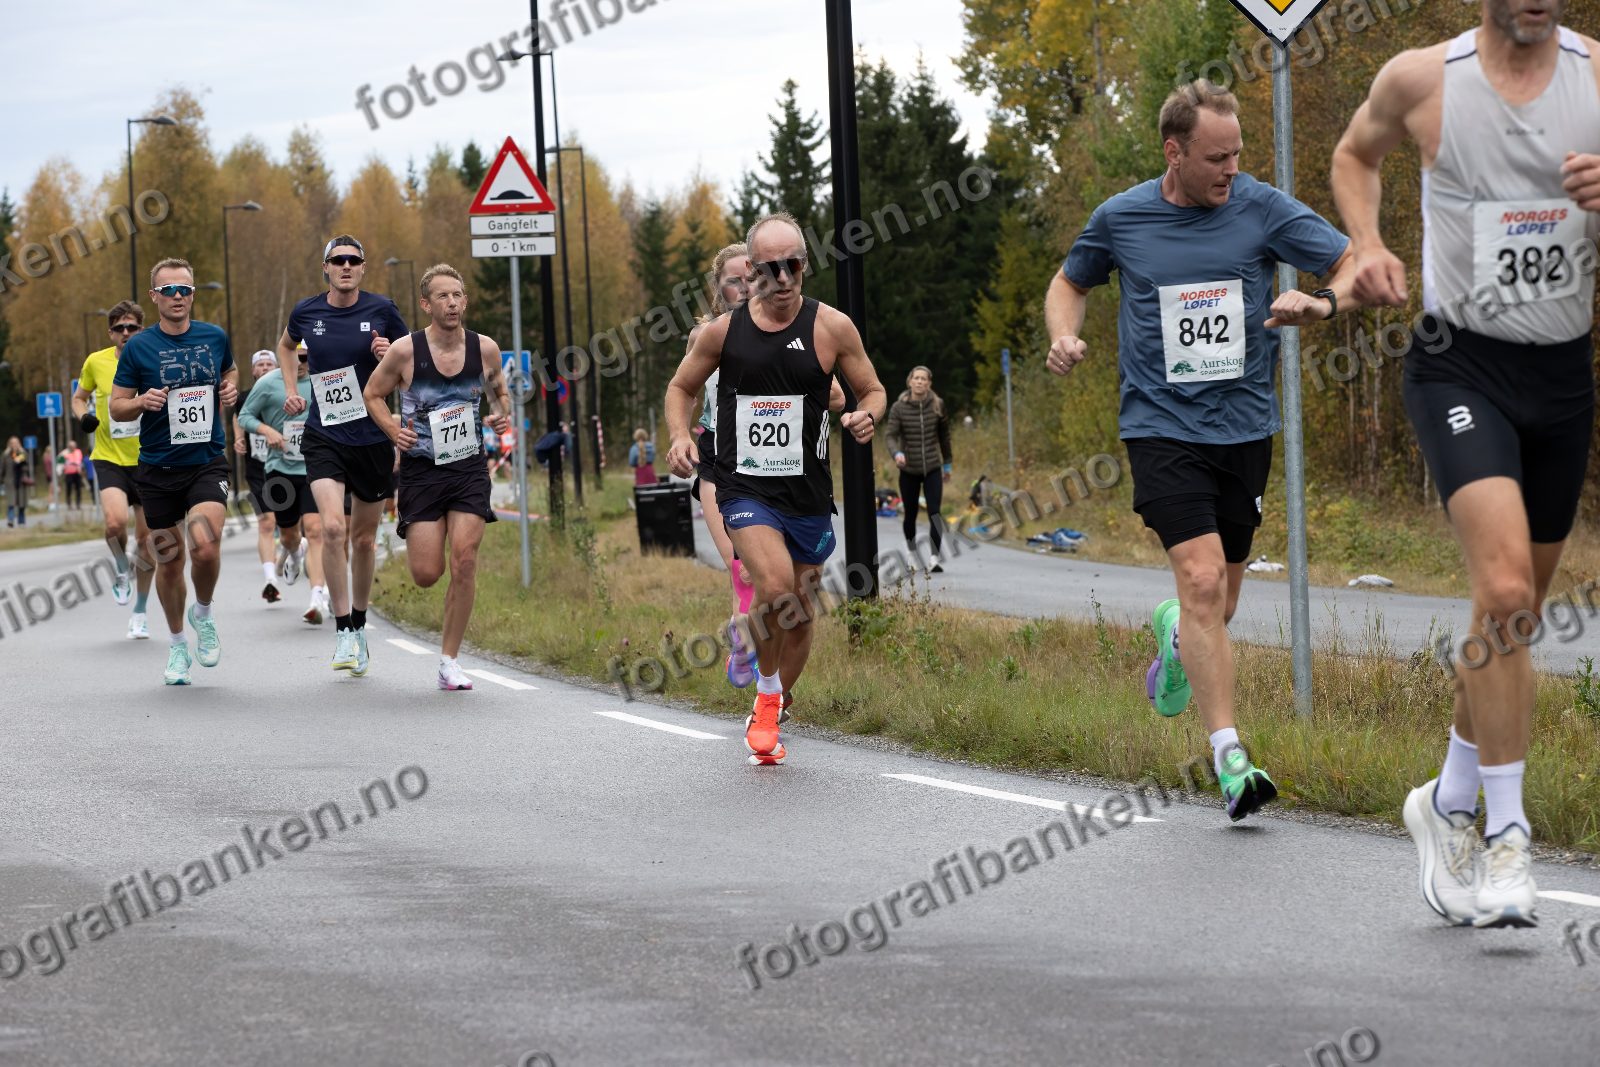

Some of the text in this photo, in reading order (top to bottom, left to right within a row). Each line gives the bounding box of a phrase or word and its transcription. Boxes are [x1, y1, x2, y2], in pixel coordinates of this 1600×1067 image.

[1500, 208, 1568, 224] NORGES
[487, 219, 539, 232] Gangfelt
[1506, 222, 1559, 236] LØPET
[519, 241, 537, 252] km
[1497, 244, 1565, 286] 382
[1177, 288, 1228, 301] NORGES
[1184, 298, 1220, 310] LØPET
[1179, 314, 1230, 347] 842
[1200, 357, 1243, 369] Aurskog
[320, 371, 347, 382] NORGES
[178, 390, 207, 399] NORGES
[325, 386, 353, 405] 423
[750, 401, 792, 410] NORGES
[178, 405, 206, 424] 361
[440, 406, 465, 419] NORGES
[753, 409, 785, 417] LØPET
[440, 421, 468, 444] 774
[748, 422, 790, 448] 620
[763, 457, 801, 468] Aurskog
